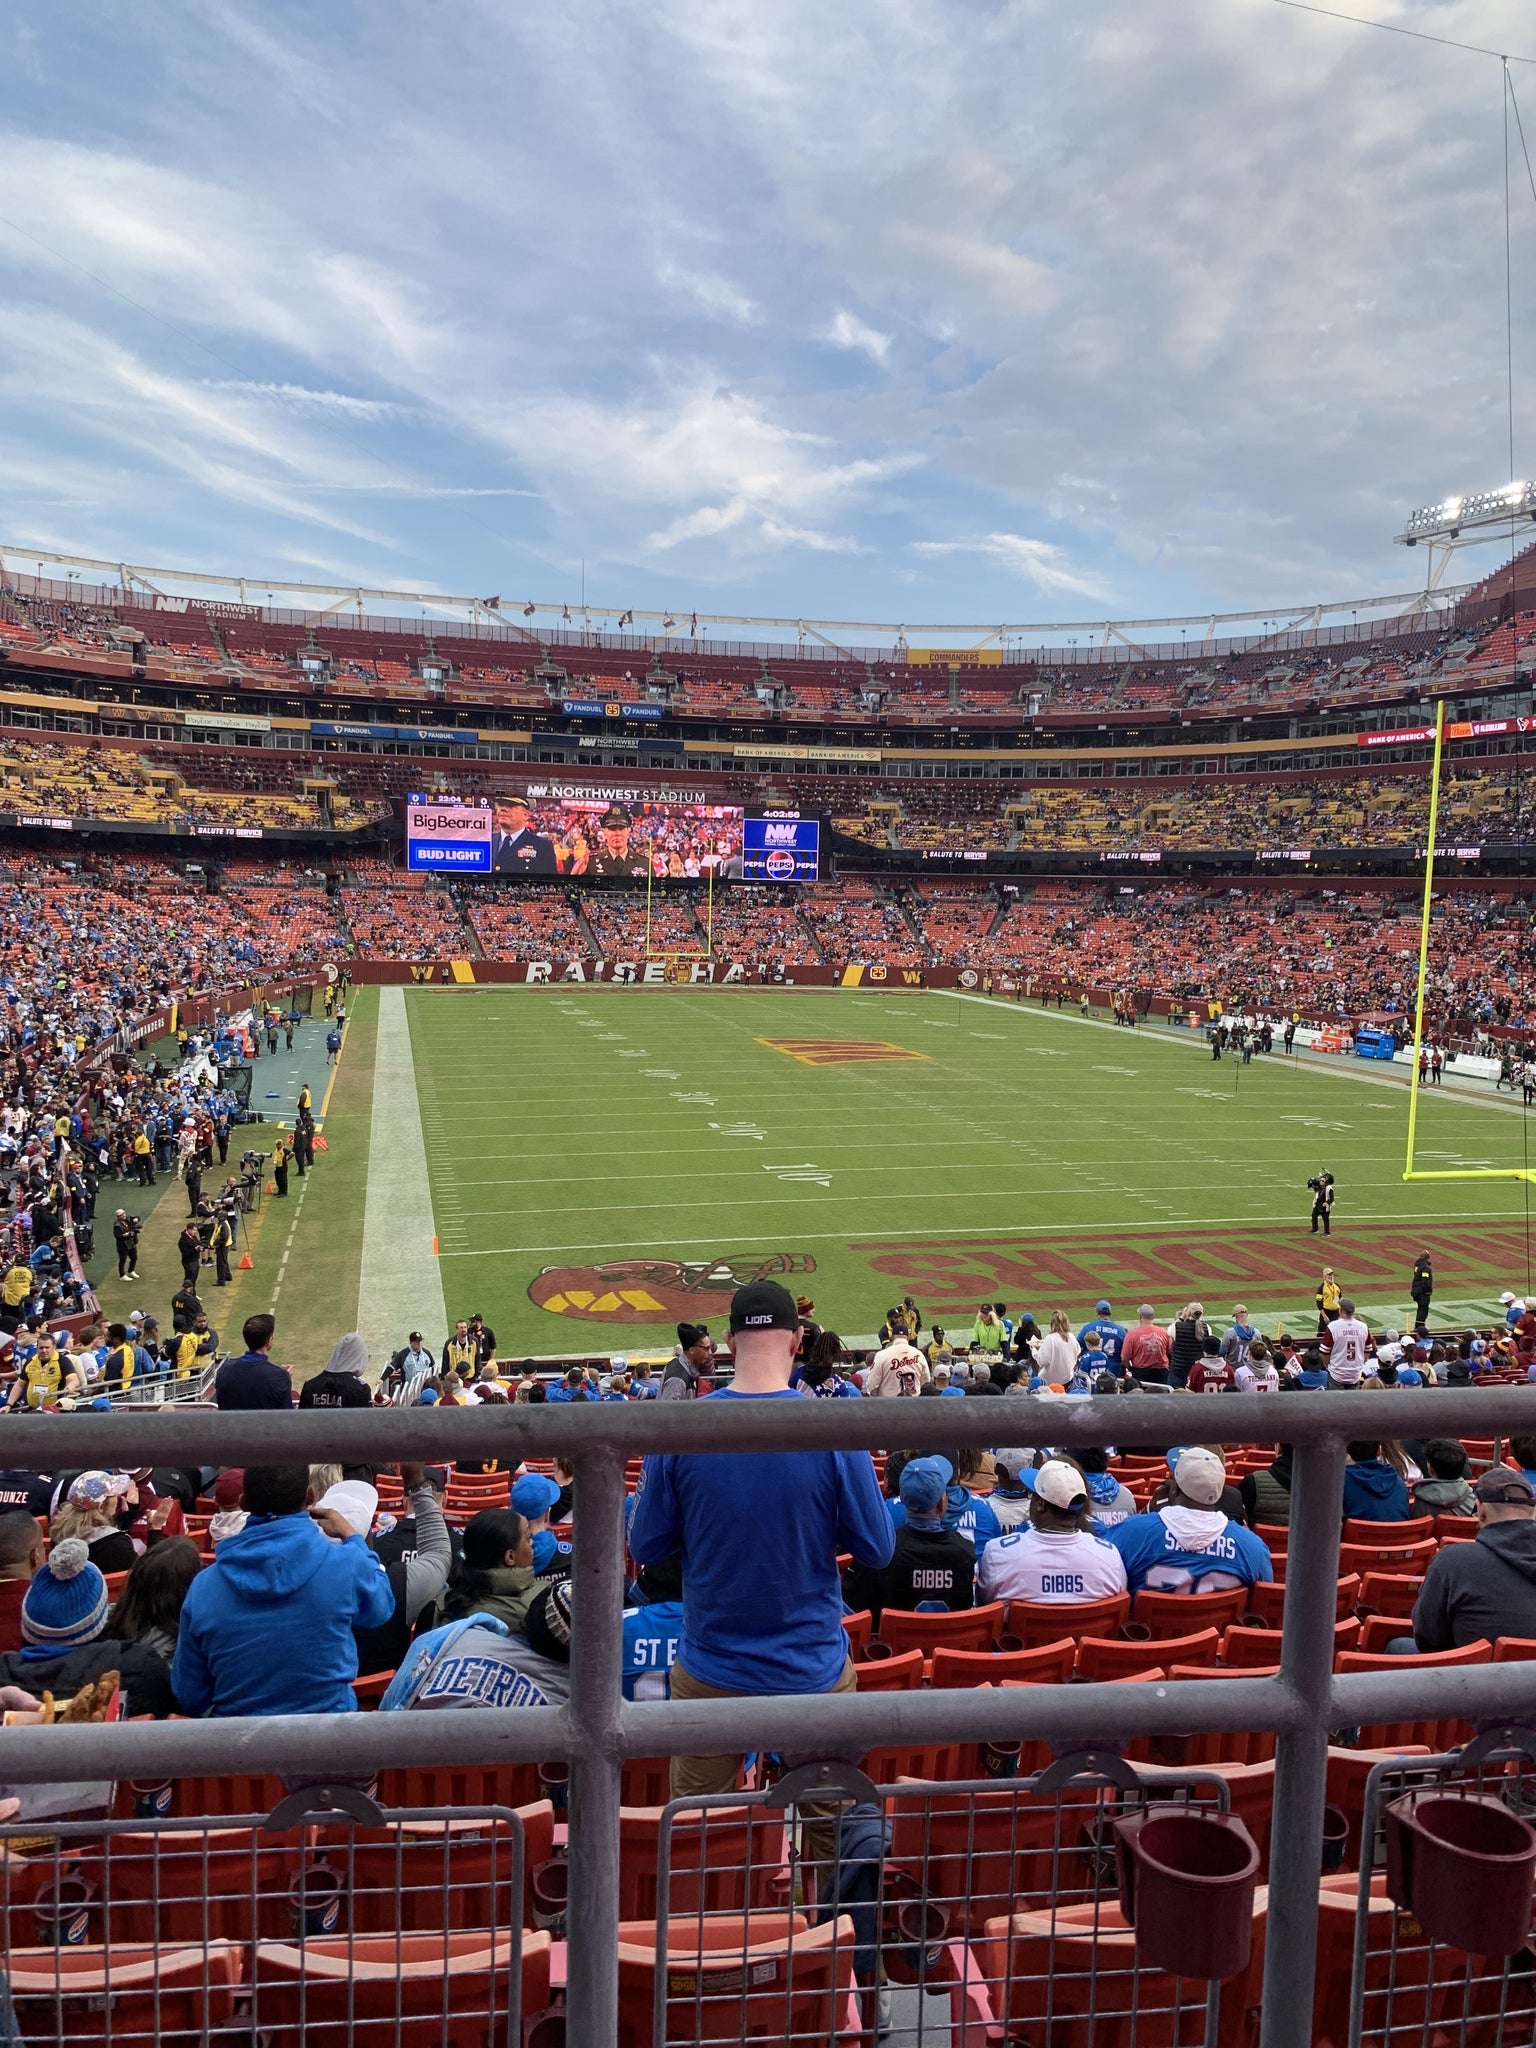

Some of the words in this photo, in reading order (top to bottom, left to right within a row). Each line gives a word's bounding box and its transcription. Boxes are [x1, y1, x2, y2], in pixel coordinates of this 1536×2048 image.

[156, 596, 189, 613] NW
[191, 600, 259, 615] NORTHWEST
[205, 610, 246, 620] STADIUM
[929, 653, 980, 662] COMMANDERS
[574, 705, 602, 713] FANDUEL
[187, 716, 212, 726] Paycor
[216, 719, 241, 728] Paycor
[245, 721, 269, 730] Paycor
[343, 727, 372, 735] FANDUEL
[428, 732, 455, 740] FANDUEL
[1395, 732, 1425, 741] AMERICA
[552, 786, 639, 800] NORTHWEST
[643, 790, 705, 803] STADIUM
[763, 810, 800, 818] 4:02:56
[22, 817, 43, 825] SALUTE
[51, 820, 72, 828] SERVICE
[414, 814, 486, 831] BigBear.ai
[198, 827, 224, 835] SALUTE
[236, 829, 262, 837] SERVICE
[418, 849, 444, 860] BUD
[445, 850, 481, 861] LIGHT
[964, 851, 987, 859] SERVICE
[1140, 852, 1161, 860] SERVICE
[1290, 851, 1310, 859] SERVICE
[1457, 848, 1480, 856] SERVICE
[745, 1314, 773, 1324] LIONS
[1346, 1341, 1356, 1361] 5
[890, 1354, 920, 1371] Detroit
[913, 1570, 953, 1589] GIBBS
[1042, 1575, 1083, 1593] GIBBS
[633, 1638, 661, 1666] ST
